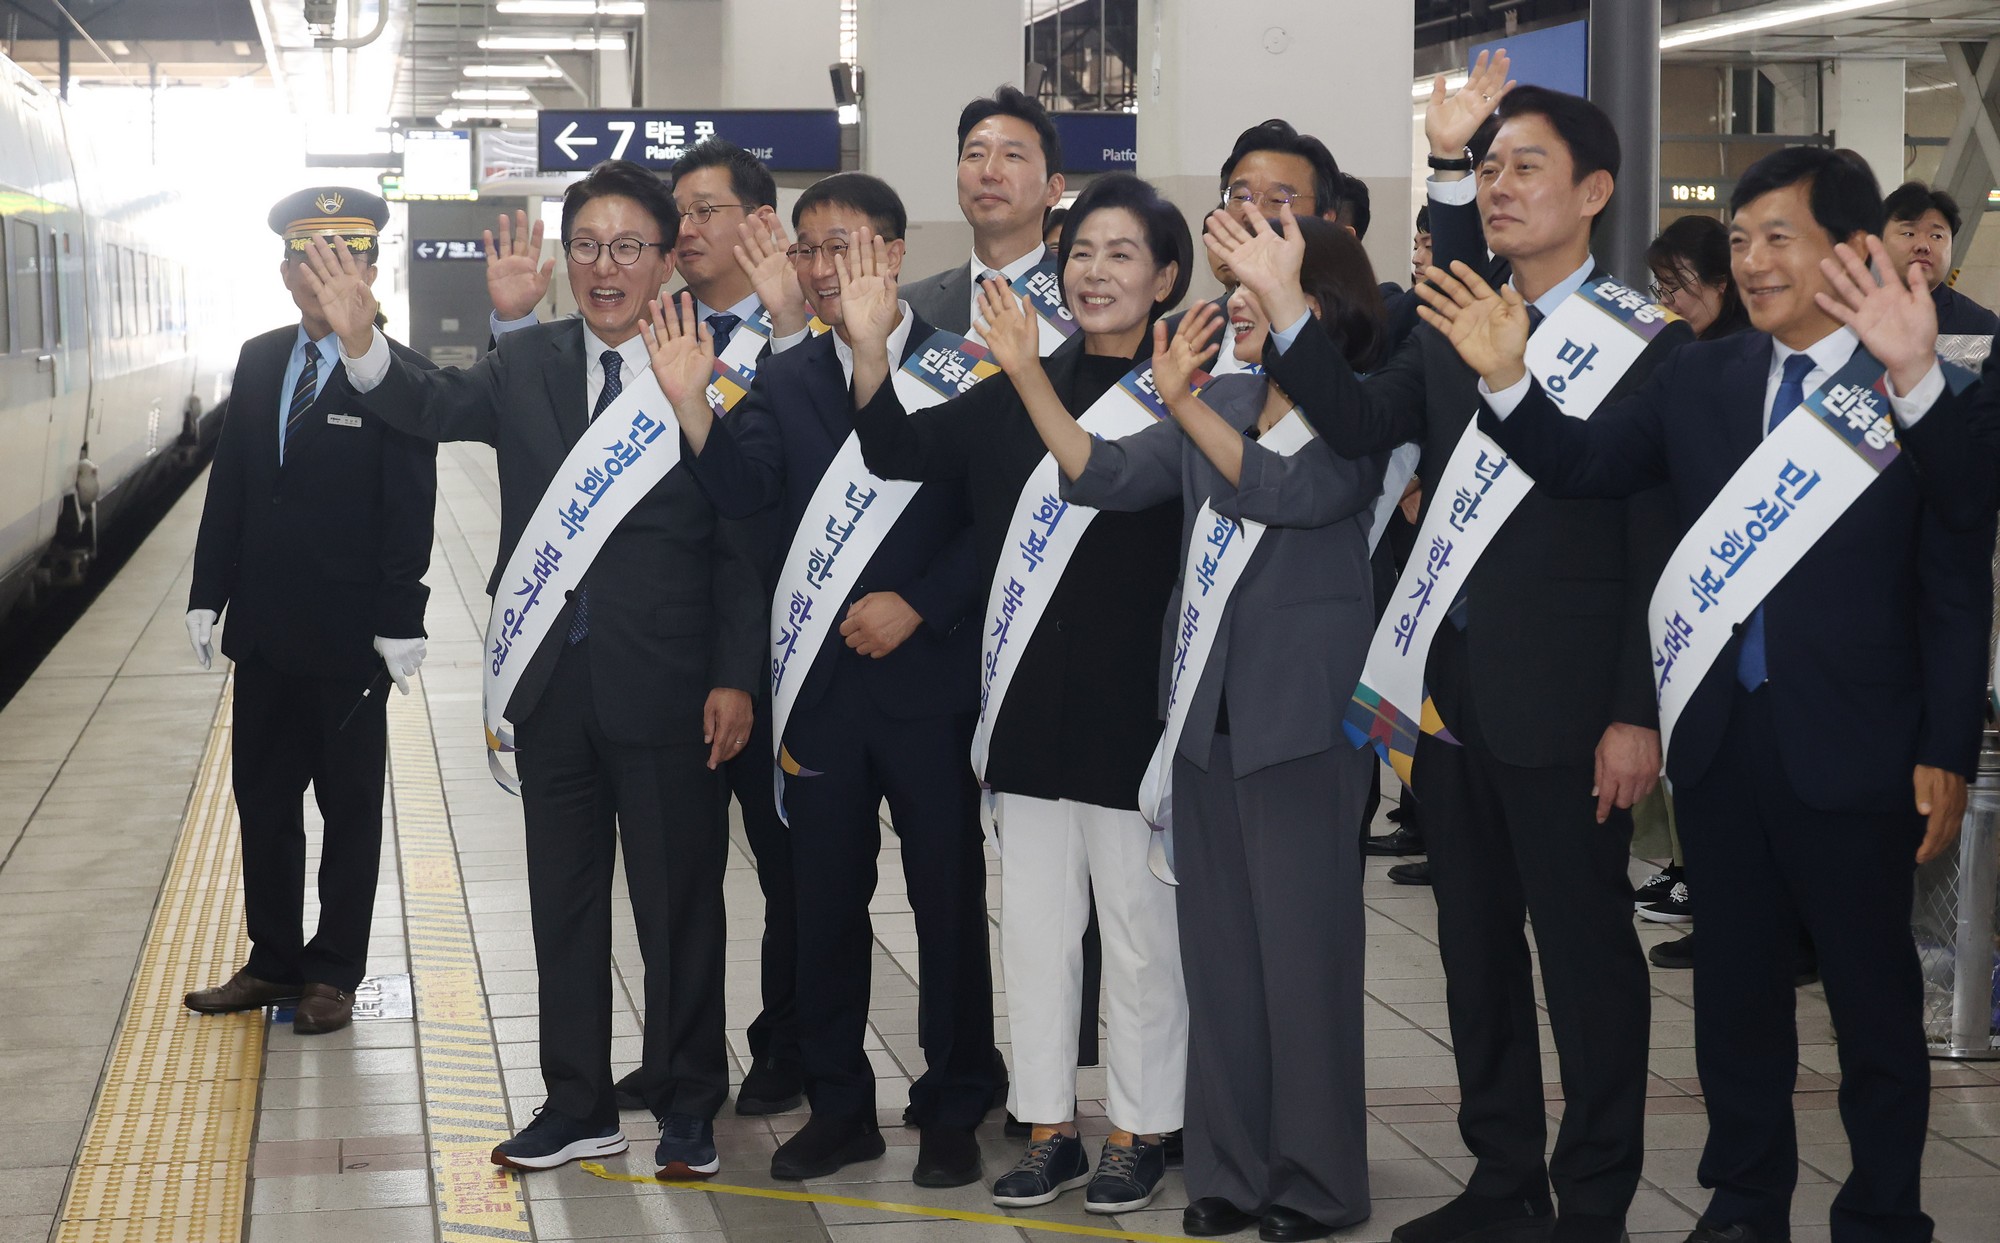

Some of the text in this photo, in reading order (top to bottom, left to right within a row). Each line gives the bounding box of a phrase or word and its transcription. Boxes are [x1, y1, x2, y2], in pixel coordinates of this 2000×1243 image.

[607, 121, 715, 160] 7 타는 곳
[646, 146, 685, 160] Platfo
[1103, 148, 1137, 161] Platfo
[1672, 185, 1715, 200] 10:54
[435, 242, 447, 258] 7
[1594, 281, 1666, 324] 민주당
[1821, 384, 1891, 450] 민주당
[1447, 450, 1509, 533] 넉한
[492, 409, 666, 677] 민생회복 물가안정
[1020, 494, 1068, 572] 회복
[1196, 515, 1236, 596] 회복
[1690, 458, 1821, 613] 민생회복
[772, 481, 877, 696] 넉넉한 한가위
[1394, 535, 1453, 657] 한가위
